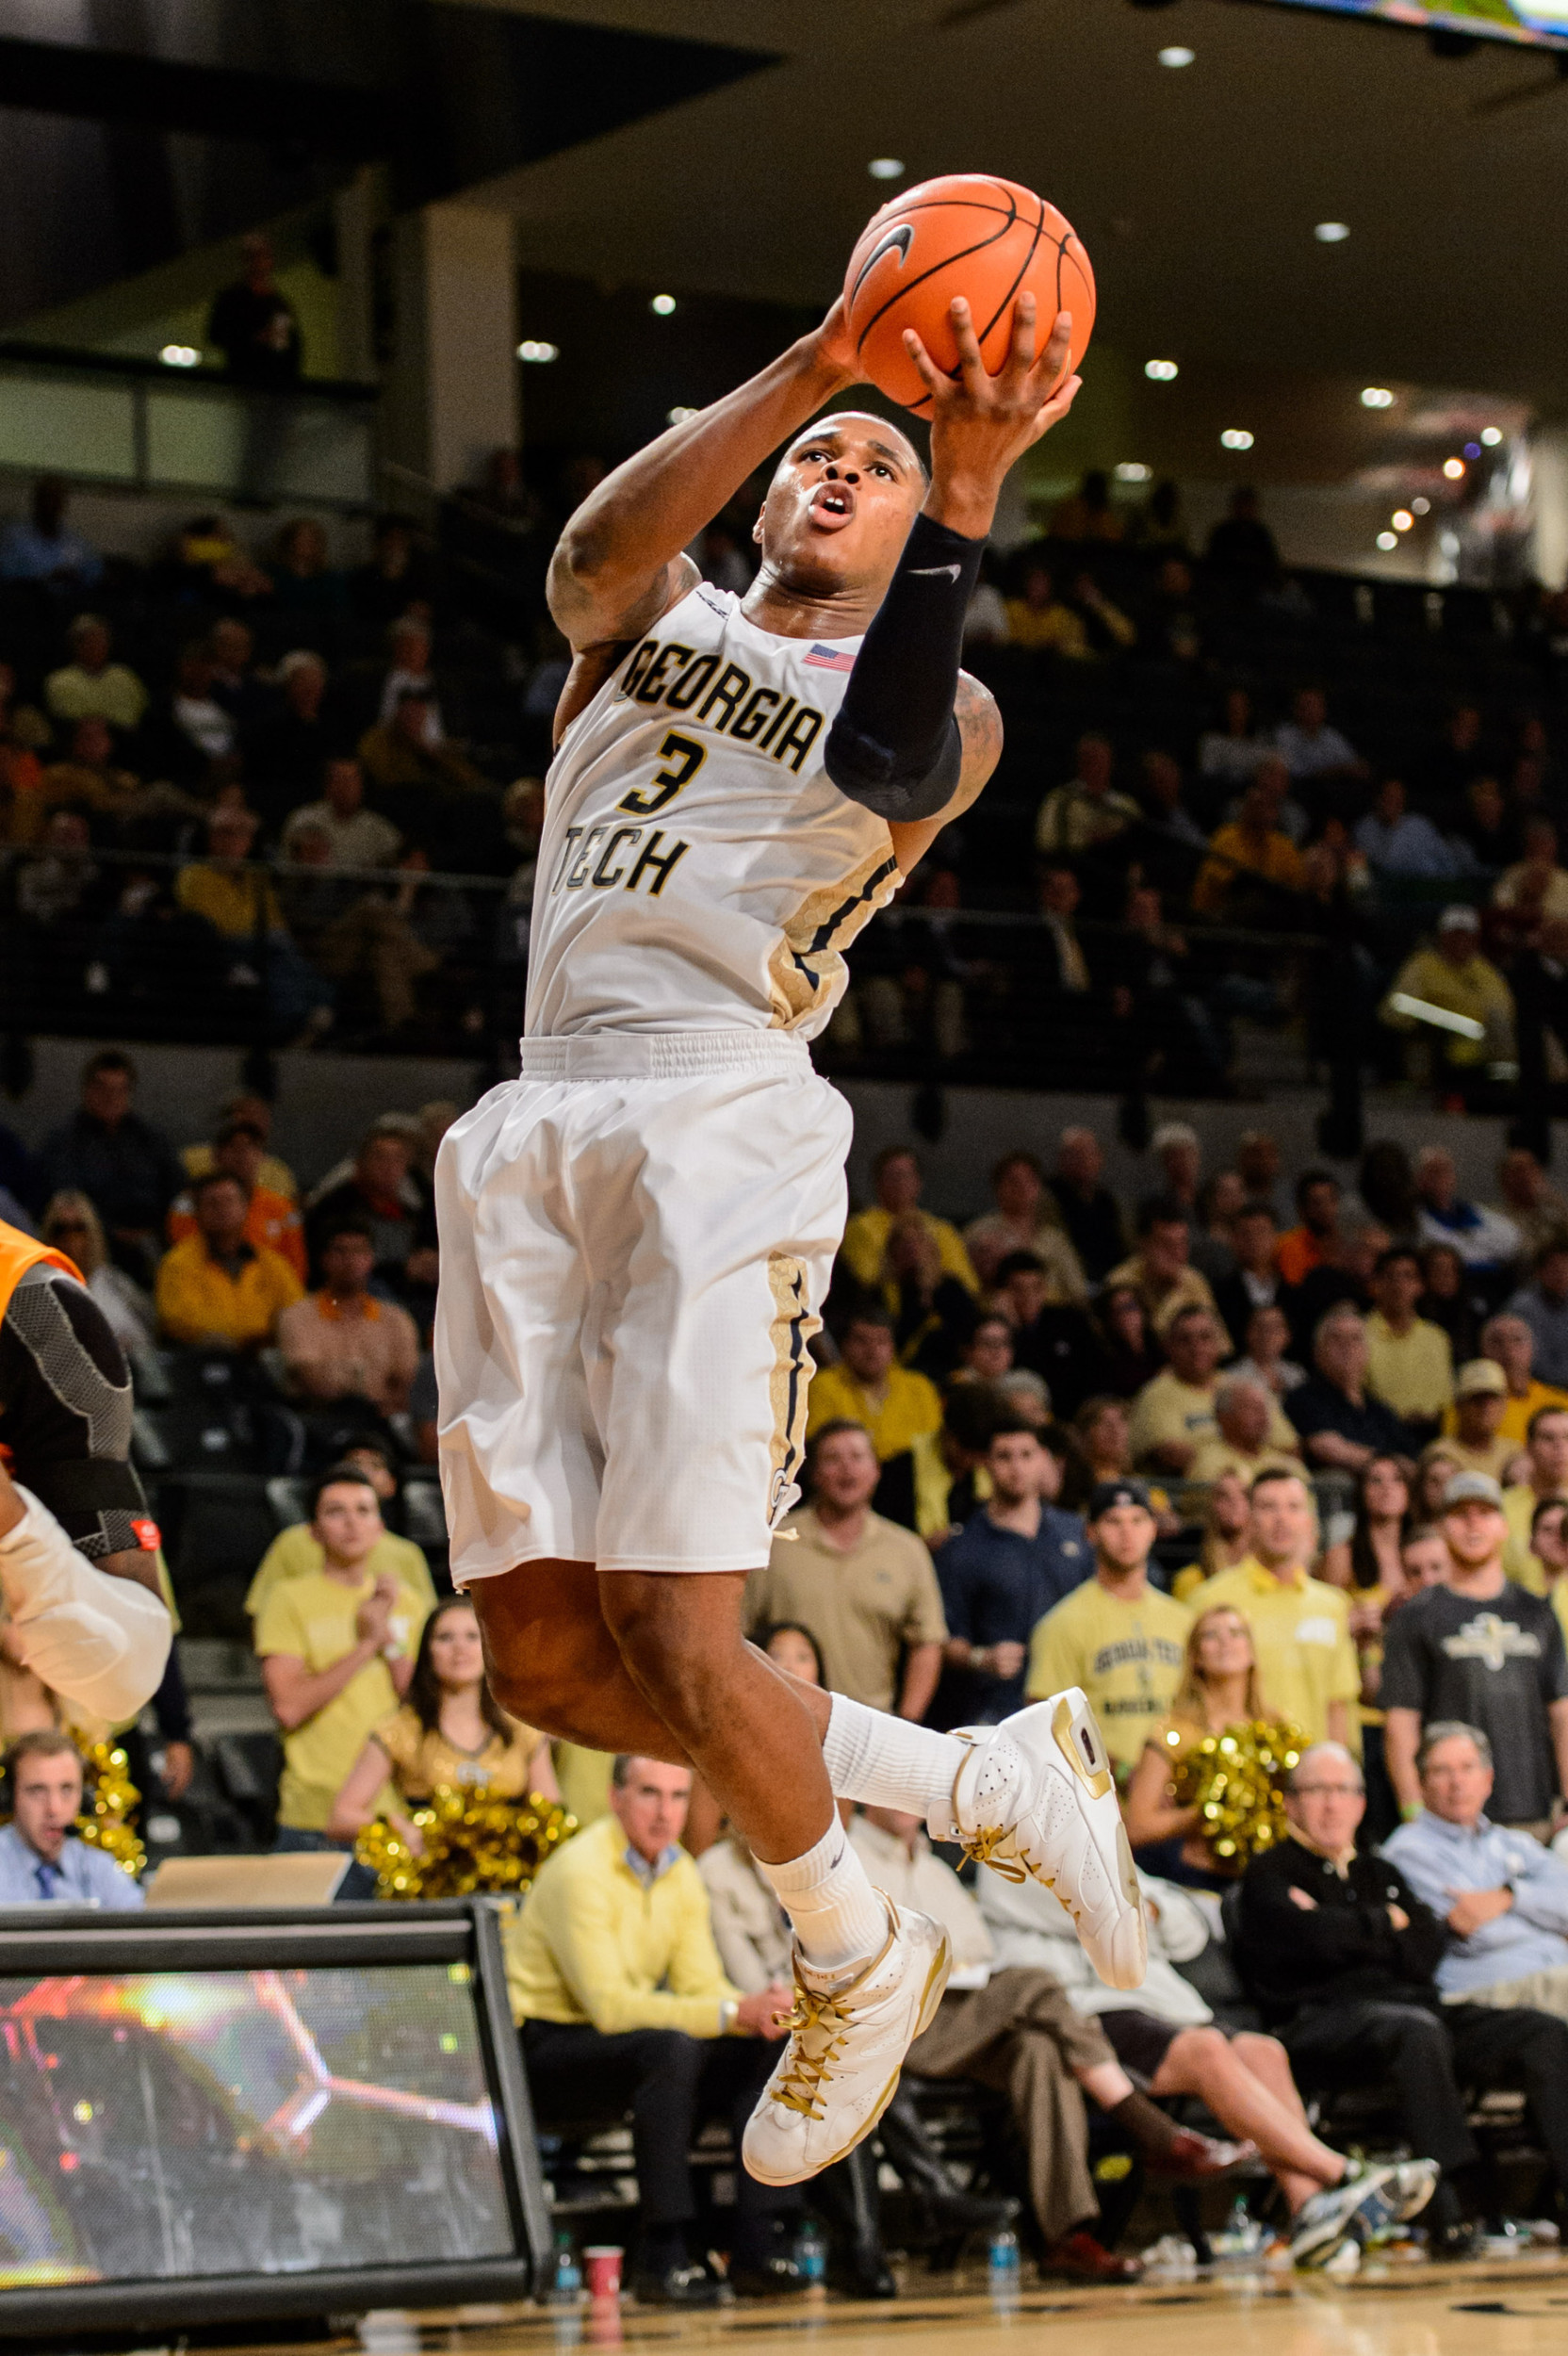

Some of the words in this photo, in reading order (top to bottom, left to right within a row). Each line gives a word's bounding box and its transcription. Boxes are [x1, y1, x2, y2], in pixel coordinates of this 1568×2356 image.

[613, 638, 826, 776] GEORGIA
[614, 728, 709, 818] 3
[550, 824, 693, 897] TECH
